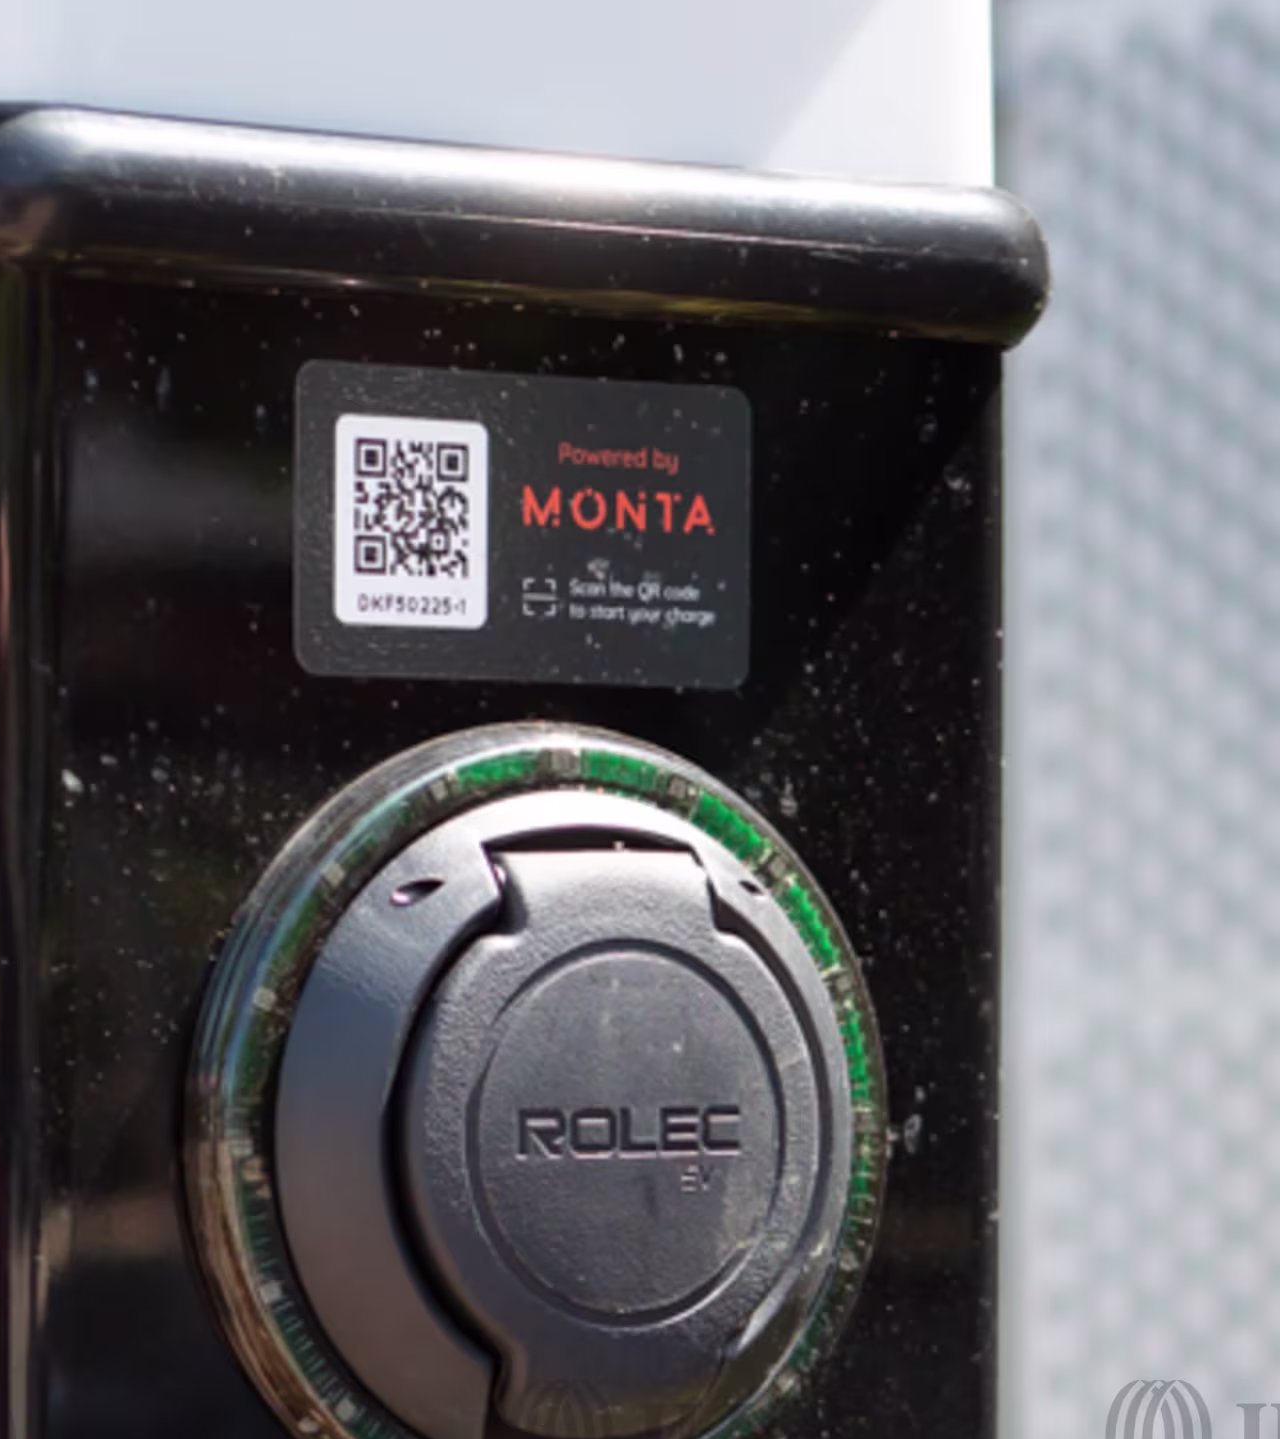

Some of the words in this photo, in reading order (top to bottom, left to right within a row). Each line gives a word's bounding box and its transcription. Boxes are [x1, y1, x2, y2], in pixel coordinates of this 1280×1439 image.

[558, 442, 648, 468] Powered
[652, 447, 679, 475] by
[522, 484, 716, 535] MONTA
[569, 578, 607, 597] Scan
[609, 578, 634, 598] the
[637, 581, 661, 602] QR
[663, 583, 700, 601] code
[569, 604, 586, 619] to
[590, 604, 624, 620] start
[627, 608, 662, 625] your
[665, 606, 715, 627] charge
[515, 1105, 741, 1161] ROLEC
[680, 1163, 711, 1193] EV
